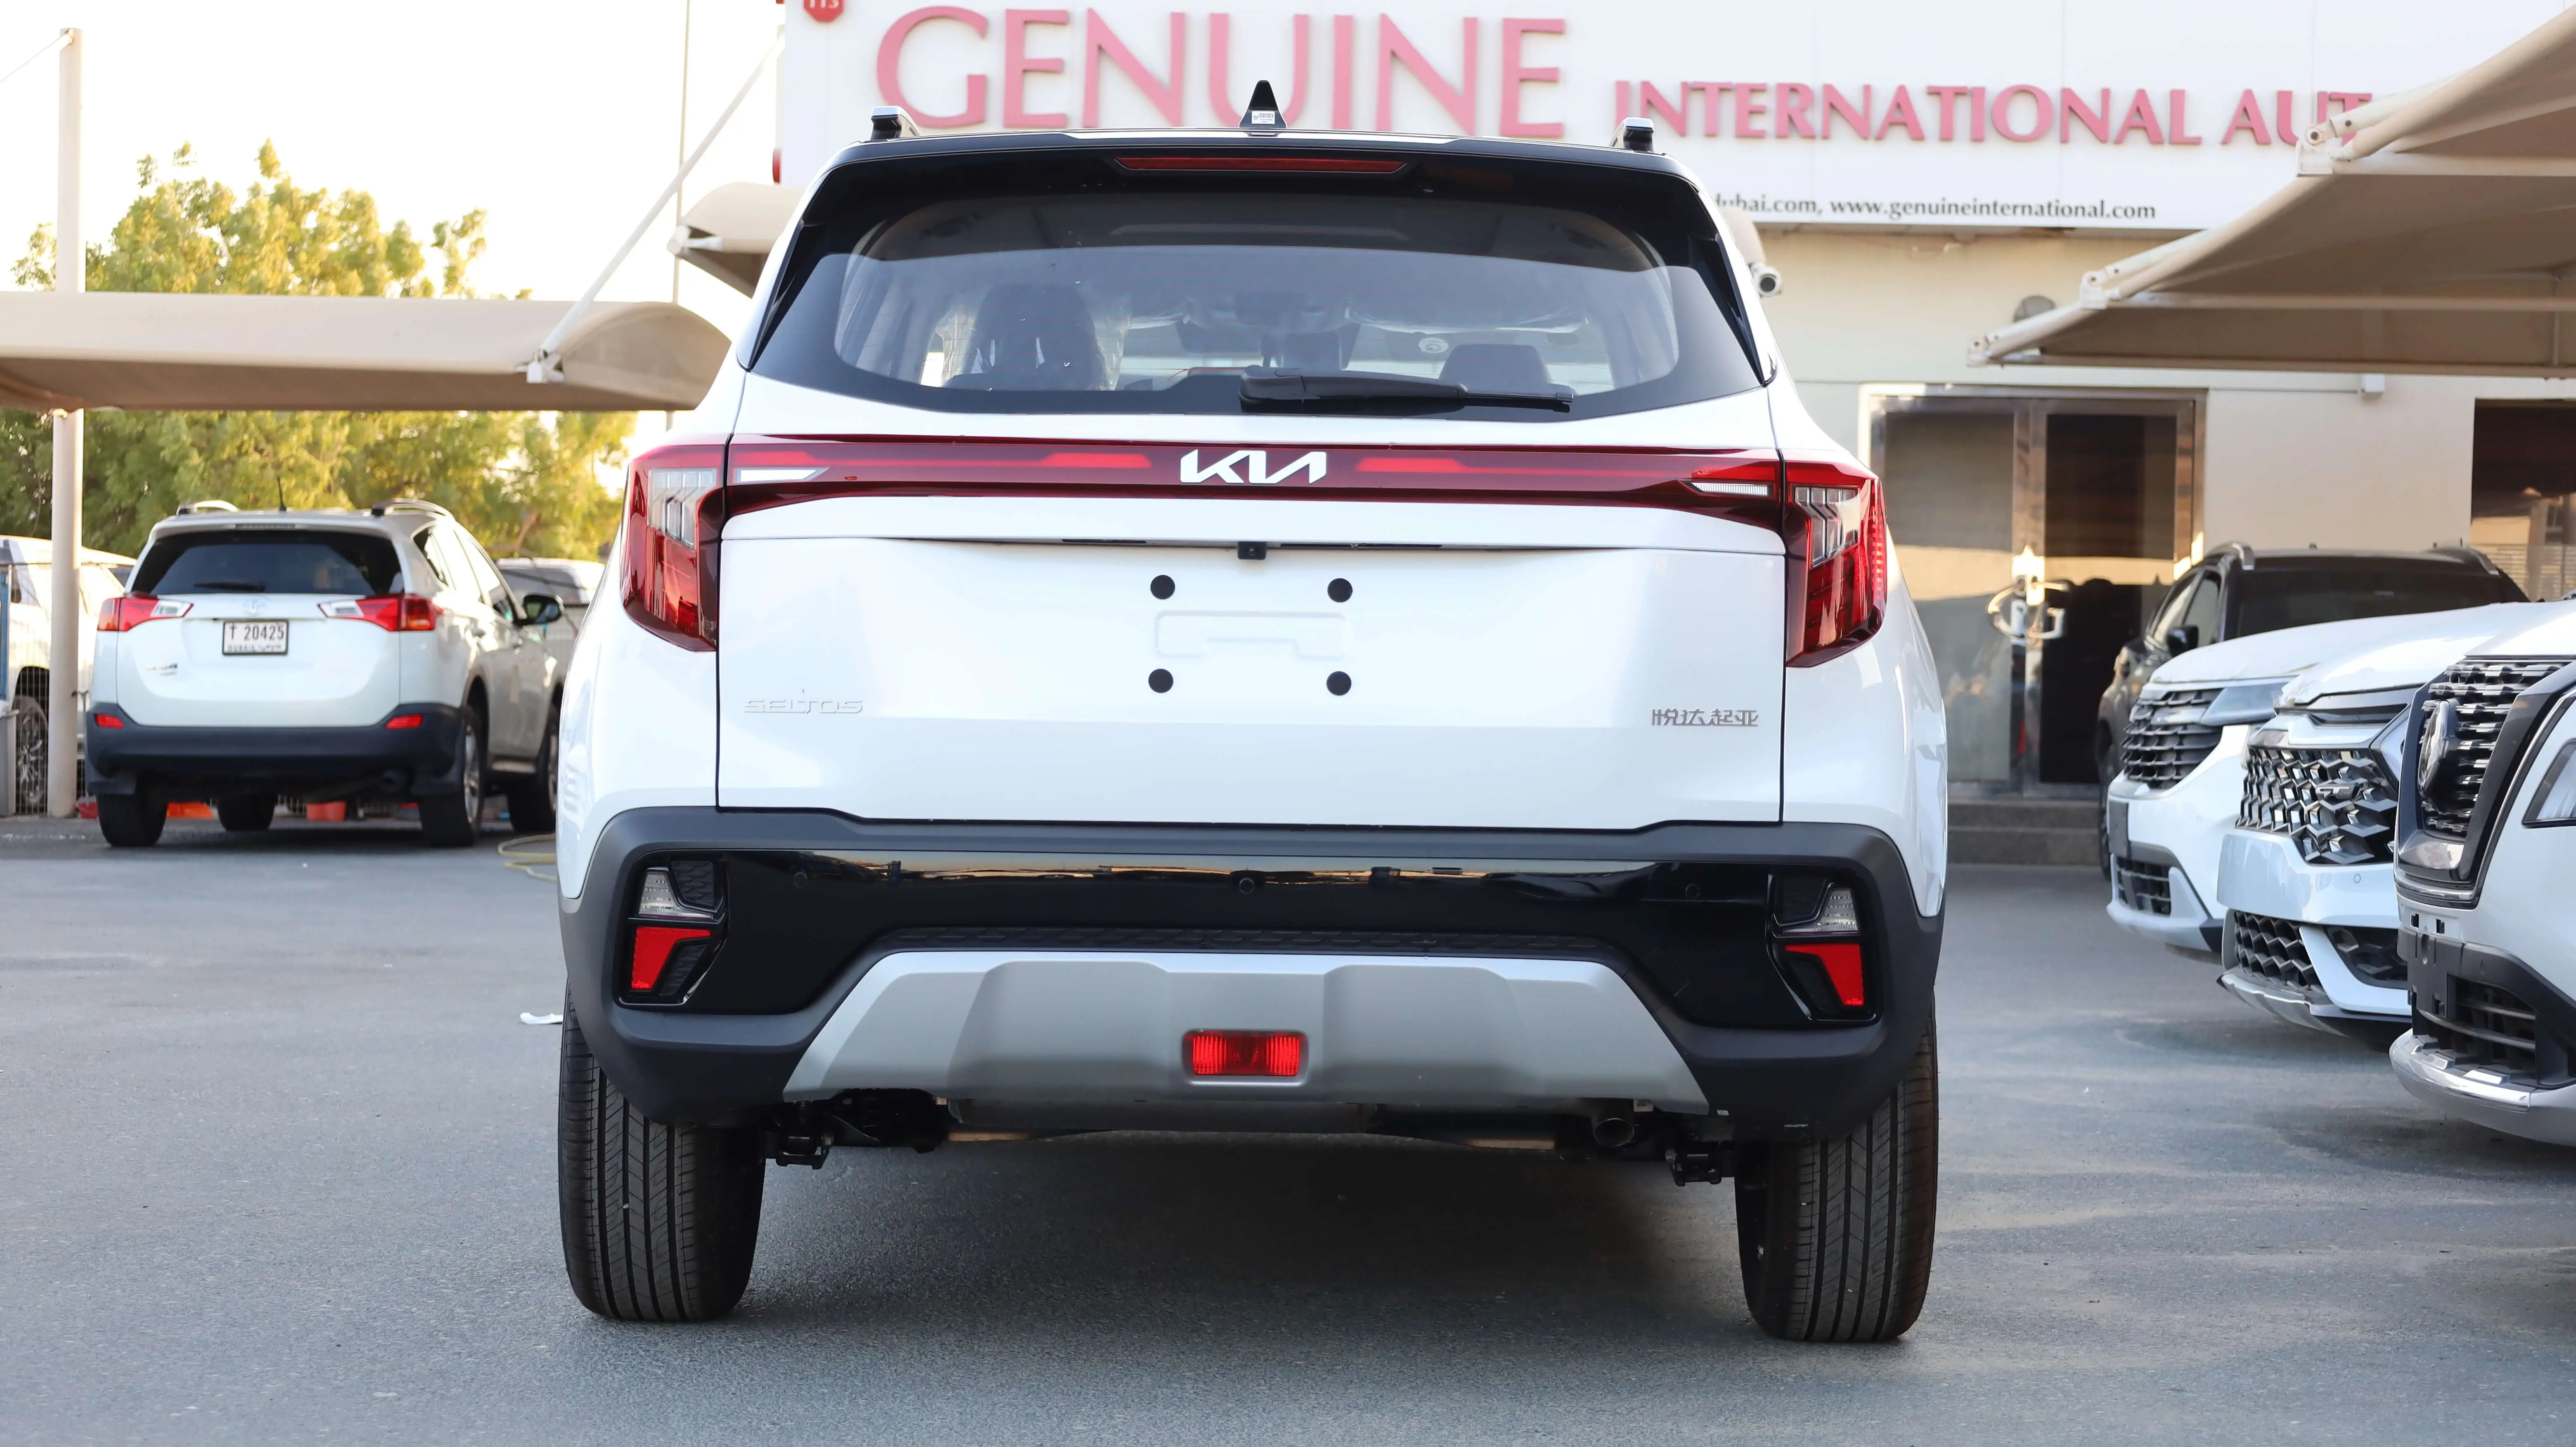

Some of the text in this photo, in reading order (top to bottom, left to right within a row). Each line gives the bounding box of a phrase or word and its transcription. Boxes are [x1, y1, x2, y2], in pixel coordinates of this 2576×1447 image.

[877, 5, 2373, 146] GENUINE INTERNATIONAL AUT
[1830, 197, 2156, 221] www.genuineinternational.com
[1180, 449, 1326, 484] KIA
[244, 624, 284, 640] 20425
[743, 700, 863, 714] SELTOS
[1651, 708, 1759, 726] 悦达起亚
